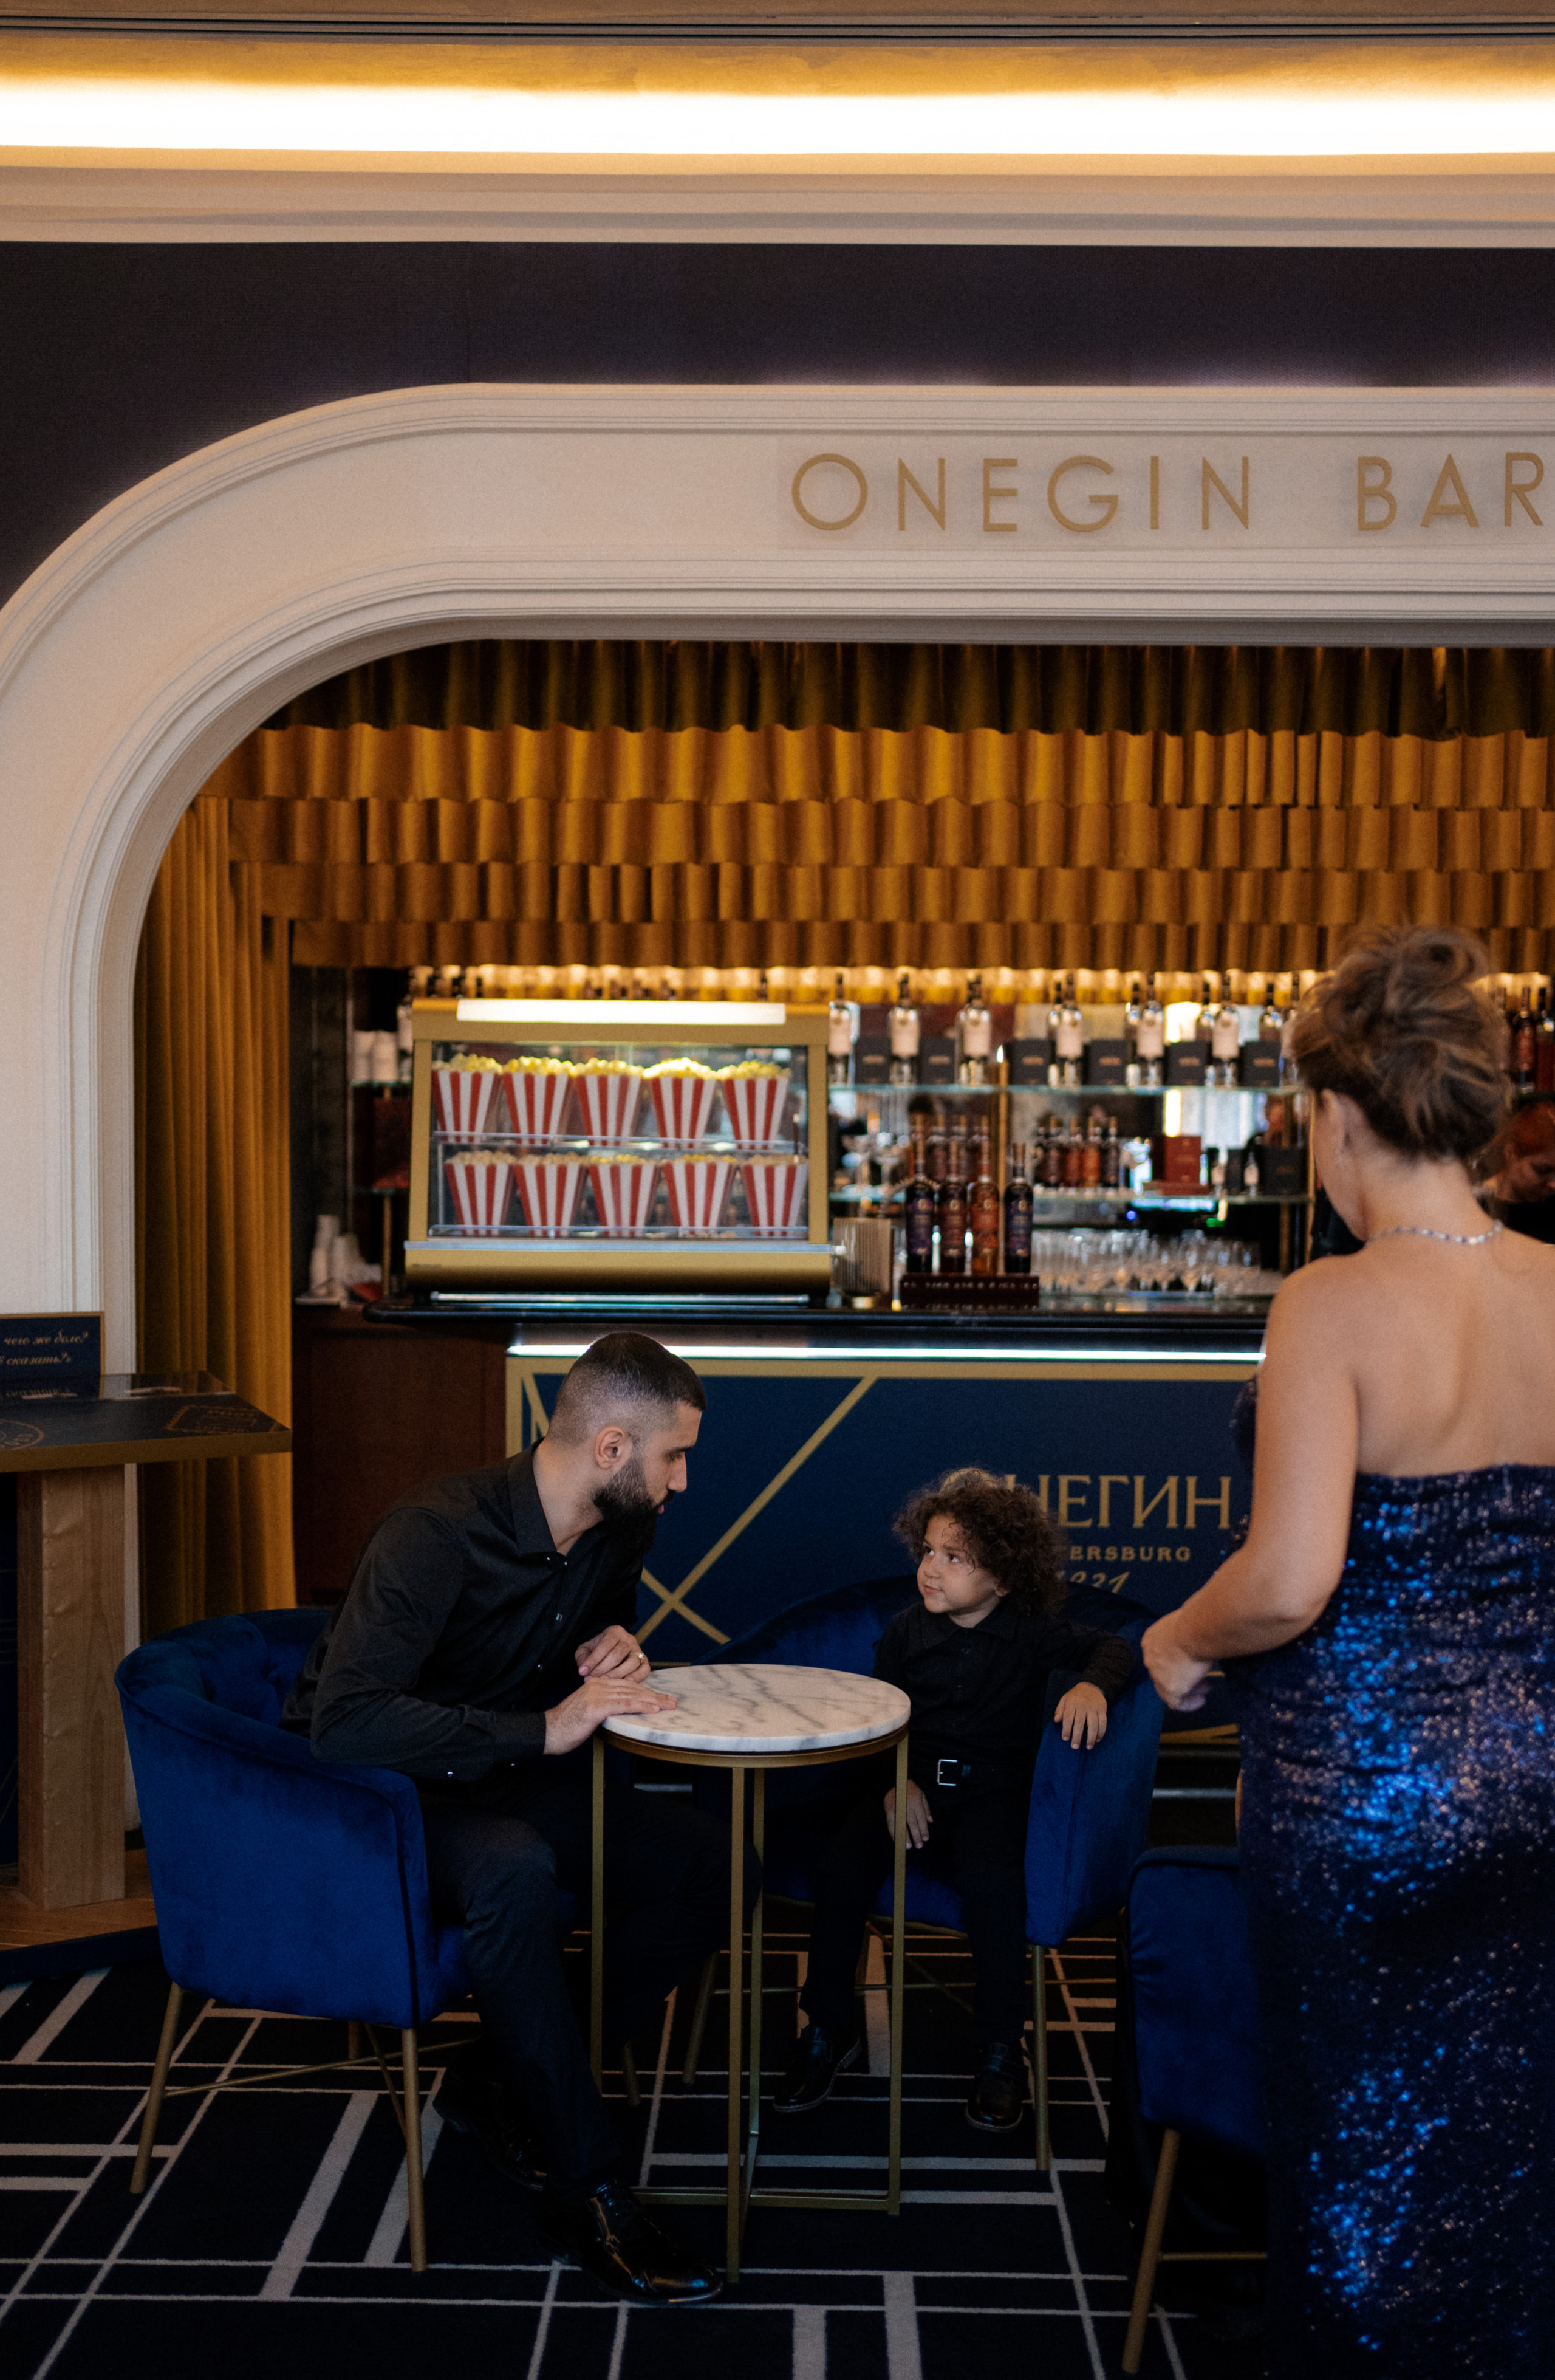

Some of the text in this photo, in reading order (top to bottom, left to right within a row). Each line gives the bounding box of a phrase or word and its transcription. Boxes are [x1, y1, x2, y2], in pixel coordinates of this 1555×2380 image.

[791, 451, 1545, 533] ONEGIN BAR
[1069, 1546, 1191, 1562] ERSBURG
